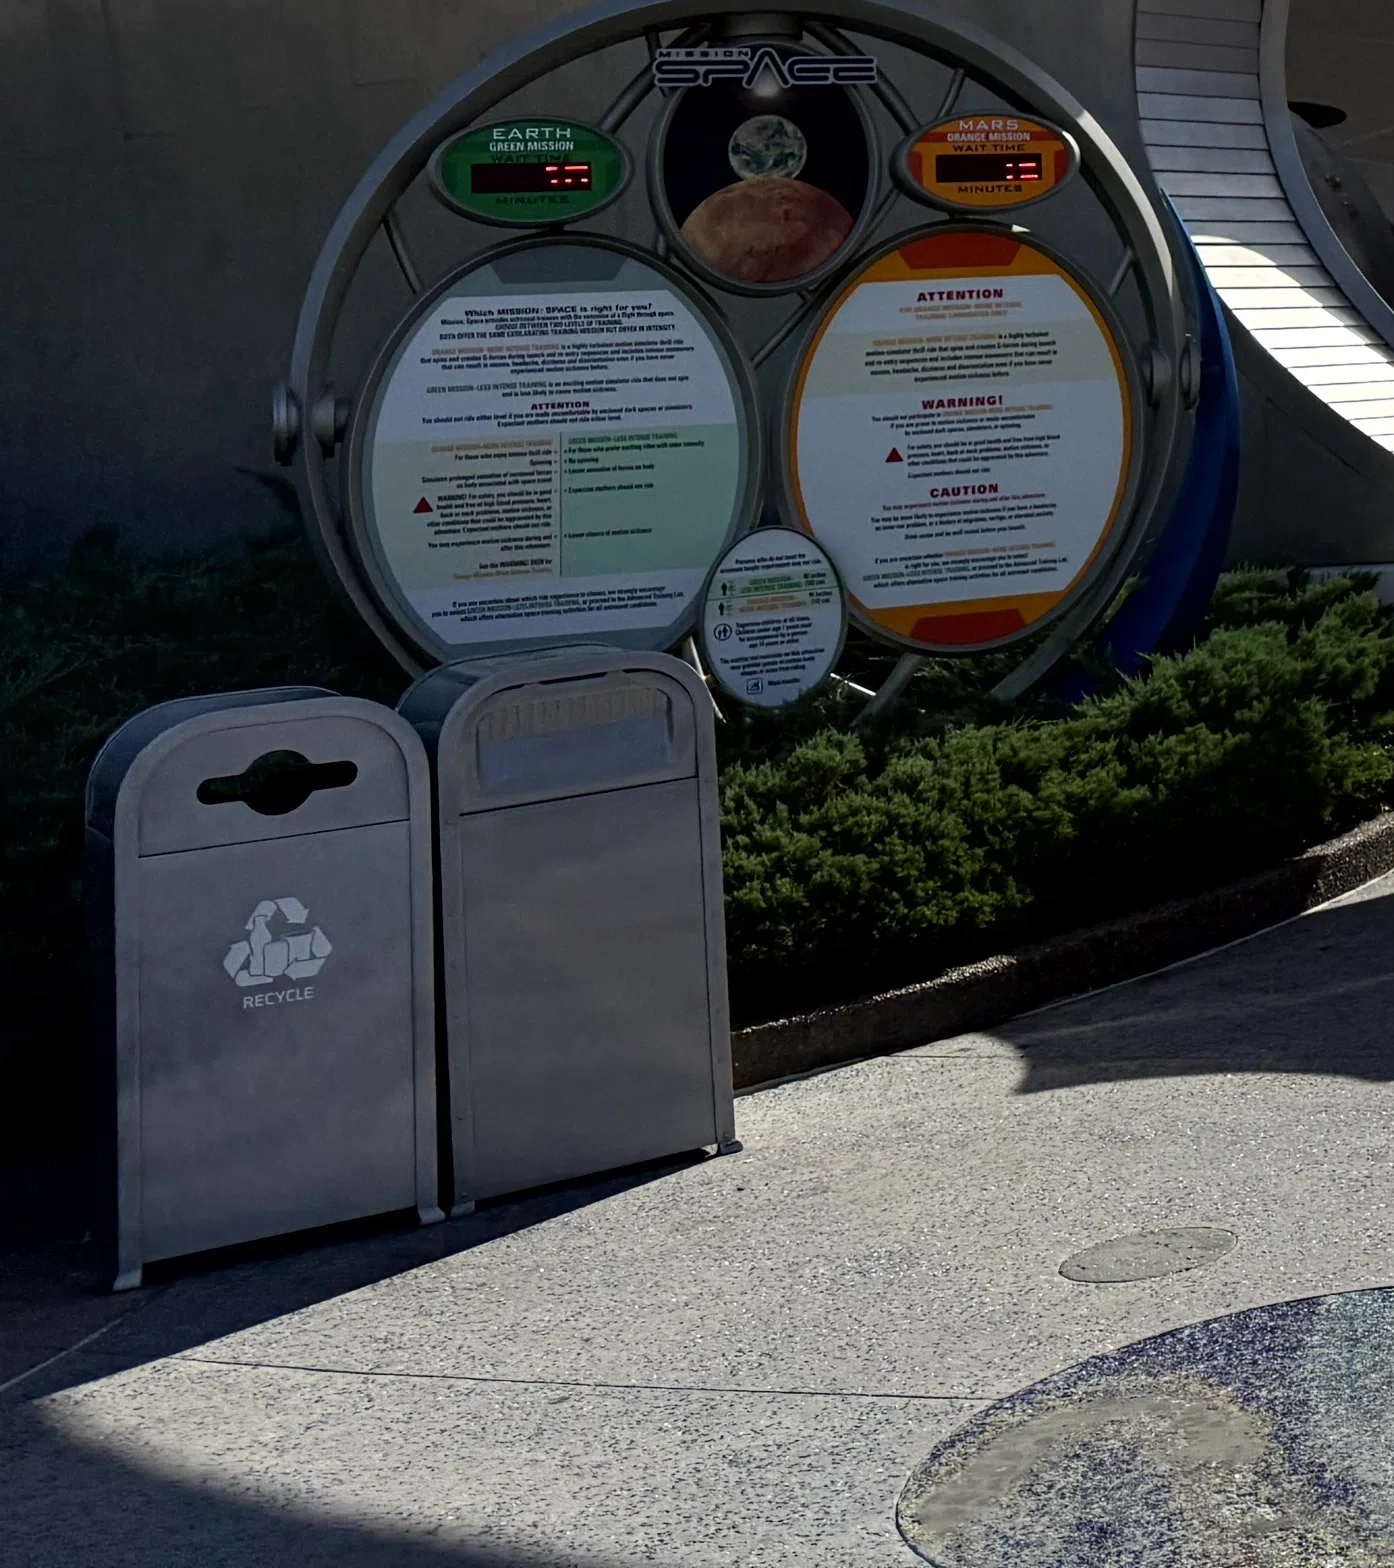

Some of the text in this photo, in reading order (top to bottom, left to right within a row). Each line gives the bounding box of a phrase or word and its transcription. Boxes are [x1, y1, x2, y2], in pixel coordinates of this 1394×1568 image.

[657, 49, 750, 59] MISSION
[653, 47, 878, 89] SPACE
[959, 119, 1019, 131] MARS
[493, 128, 571, 140] EARTH
[947, 131, 1030, 142] ORANGE MISSION
[489, 141, 574, 152] GREEN MISSION
[952, 143, 1025, 153] WAIT TIME
[958, 184, 1023, 194] MINUTES
[495, 194, 569, 205] MINUTES
[917, 289, 1003, 302] ATTENTION
[465, 309, 495, 317] Which
[591, 305, 613, 313] right
[531, 401, 590, 411] ATTENTION
[921, 395, 1003, 410] WARNING!
[930, 484, 998, 498] CAUTION
[243, 986, 315, 1009] RECYCLE
